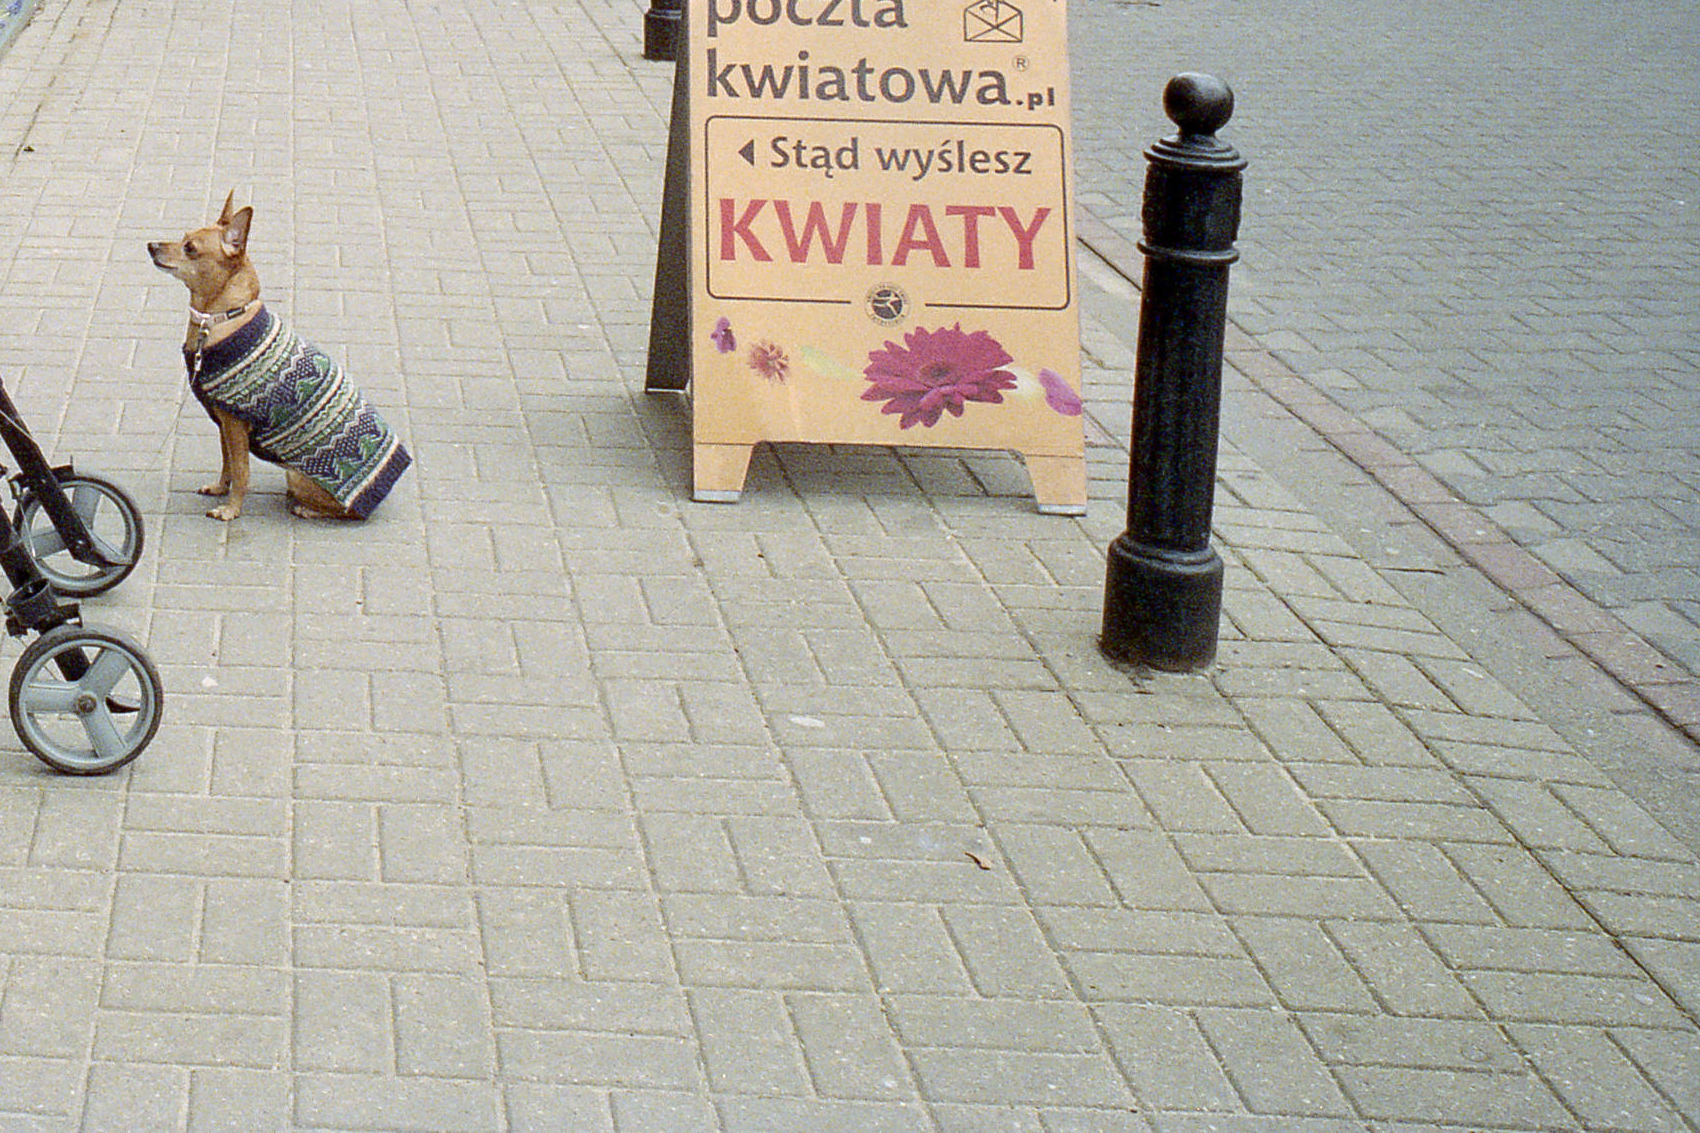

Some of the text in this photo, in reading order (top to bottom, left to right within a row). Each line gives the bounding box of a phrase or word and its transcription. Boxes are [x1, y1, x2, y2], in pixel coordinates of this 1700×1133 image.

[770, 135, 1033, 181] Stąd wyślesz
[719, 198, 1052, 270] KWIATY
